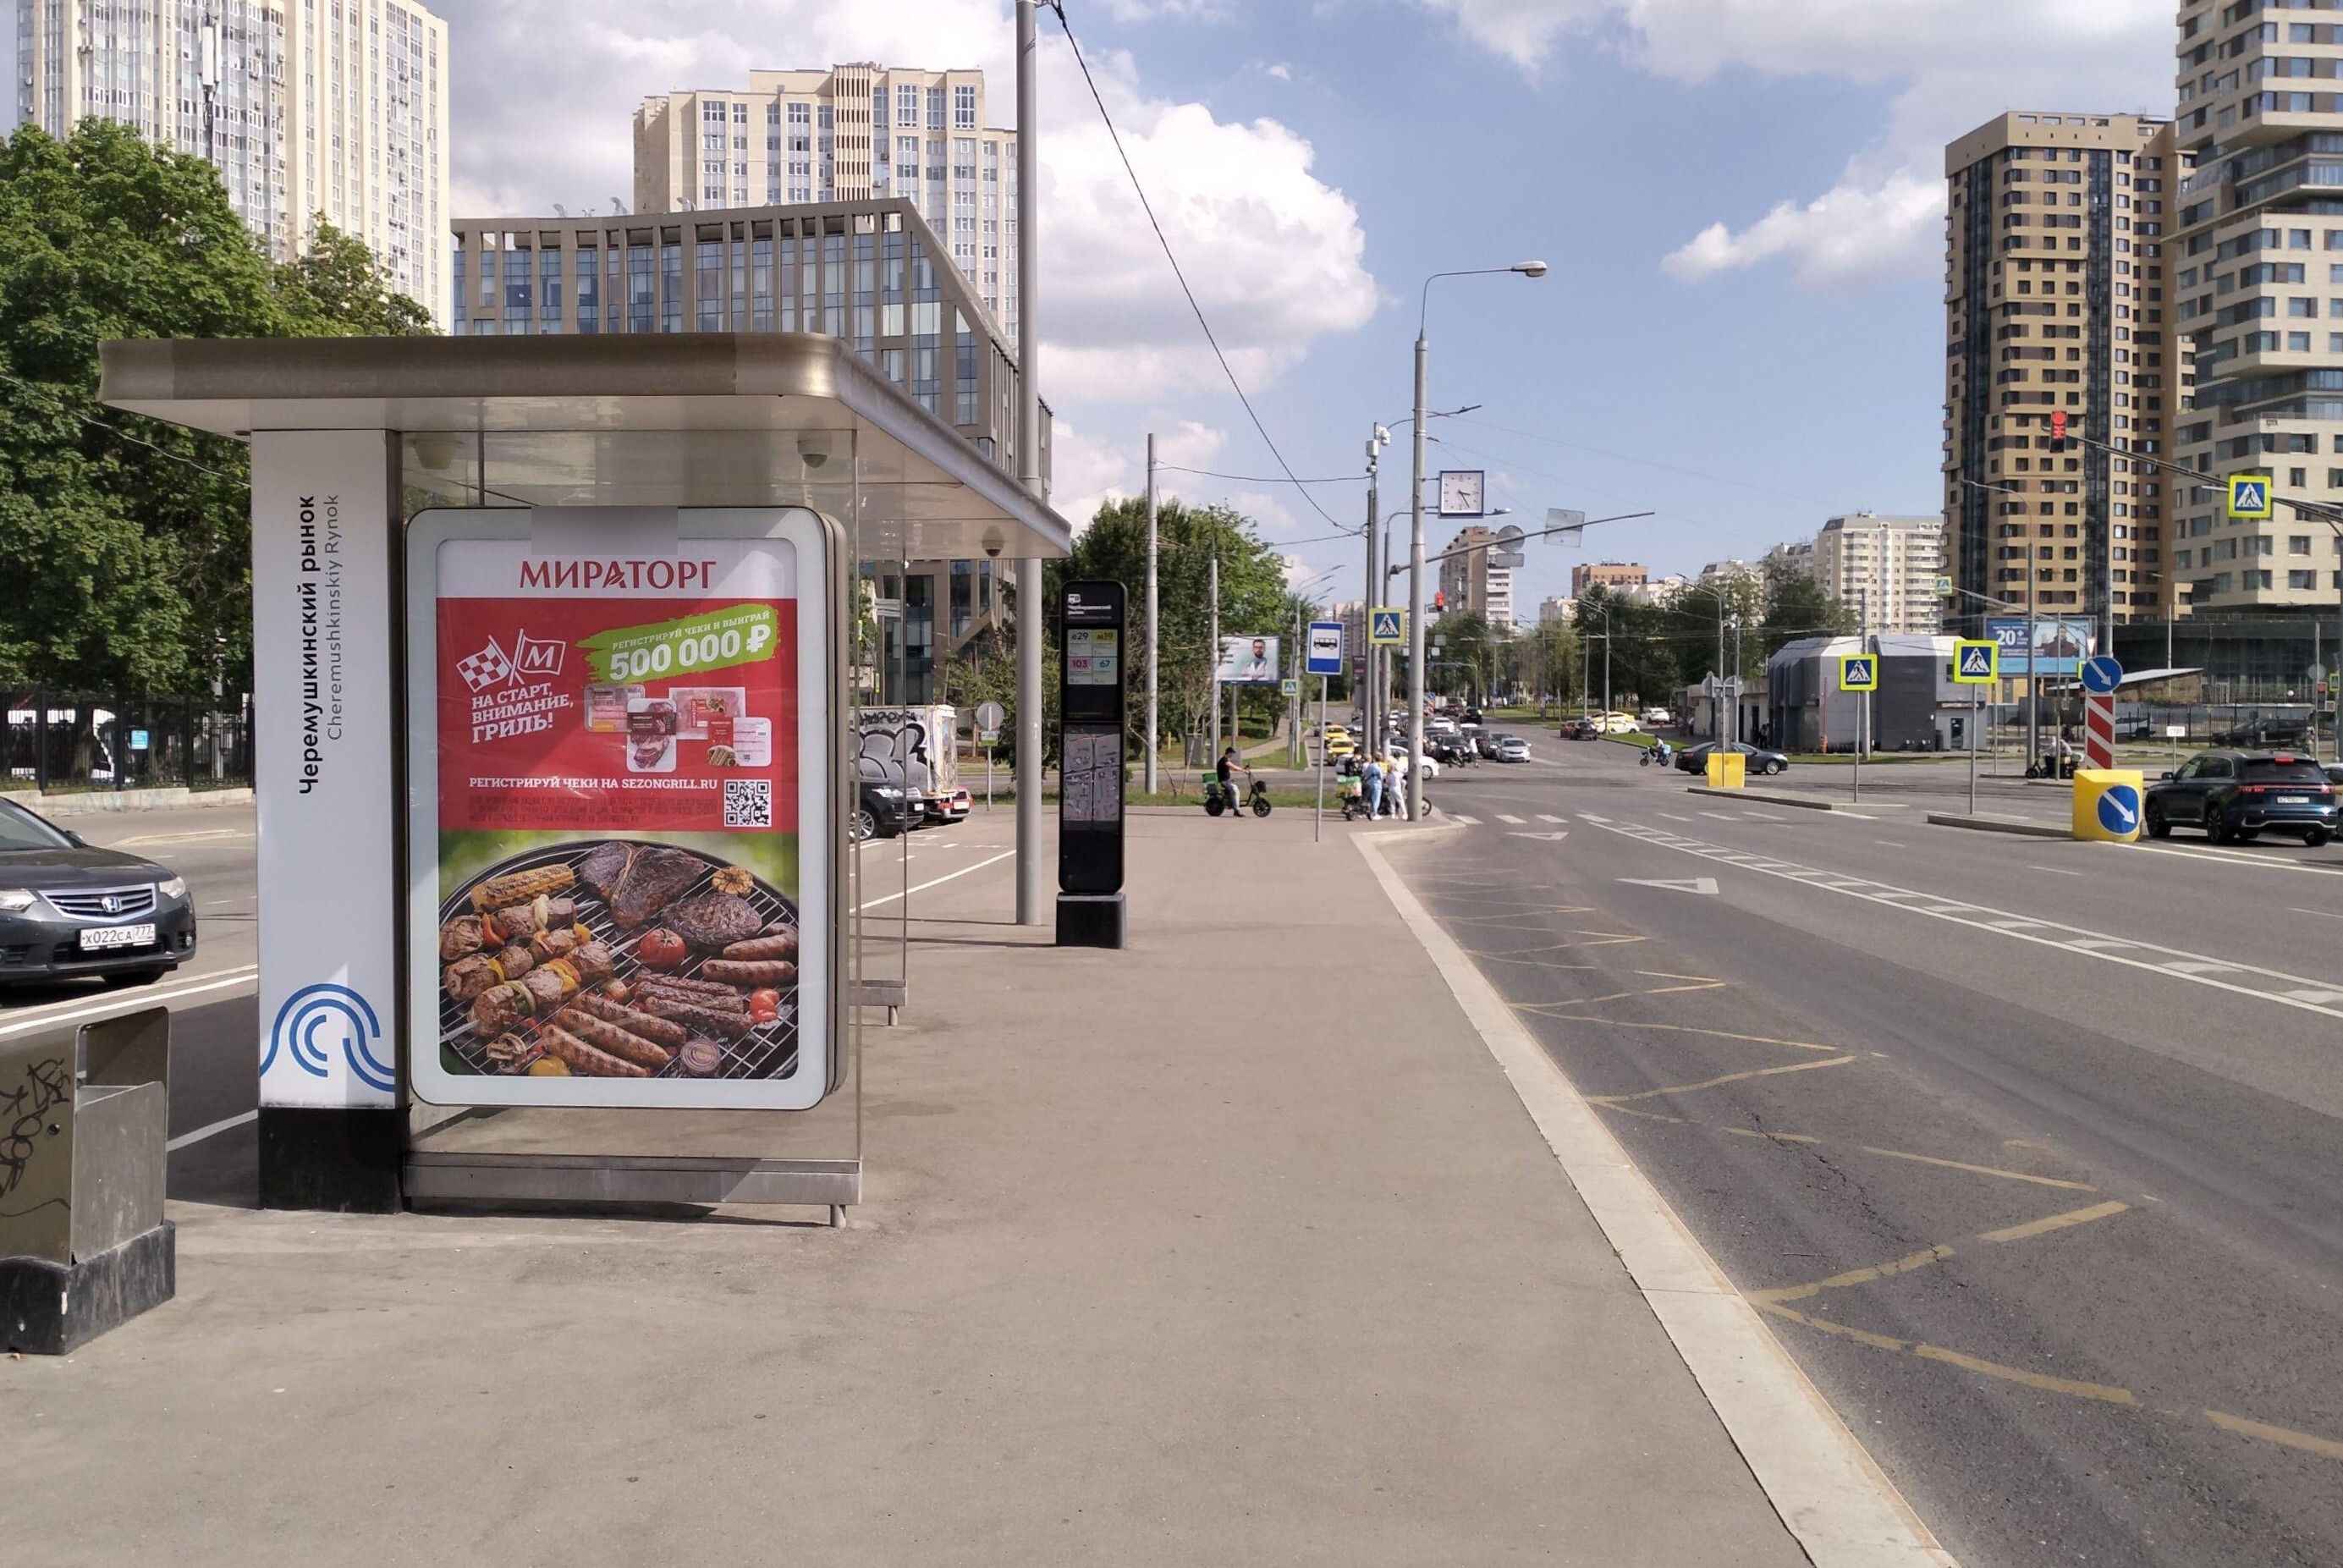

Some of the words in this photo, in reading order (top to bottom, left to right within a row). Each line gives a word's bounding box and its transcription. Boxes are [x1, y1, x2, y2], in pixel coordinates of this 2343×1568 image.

[300, 495, 321, 573] рынок
[323, 494, 343, 554] Rynok
[520, 560, 717, 590] МИРАТОРГ
[612, 628, 683, 651] РЕГИСТРИРУЙ
[685, 624, 712, 636] ЧЕКИ
[713, 621, 721, 630] И
[723, 610, 770, 628] ВЫИГРАЙ
[324, 558, 343, 741] Cheremushkinskiy
[609, 644, 672, 681] 500
[679, 630, 740, 668] 000
[297, 582, 322, 795] Черемушкинский
[471, 695, 494, 710] НА
[497, 682, 553, 704] СТАРТ,
[471, 694, 575, 724] ВНИМАНИЕ,
[472, 712, 553, 744] ГРИЛЬ!
[469, 776, 560, 789] РЕГИСТРИРУЙ
[563, 778, 598, 789] ЧЕКИ
[602, 778, 619, 789] НА
[621, 778, 718, 789] SEZONGRILL.RU
[135, 925, 151, 937] 777
